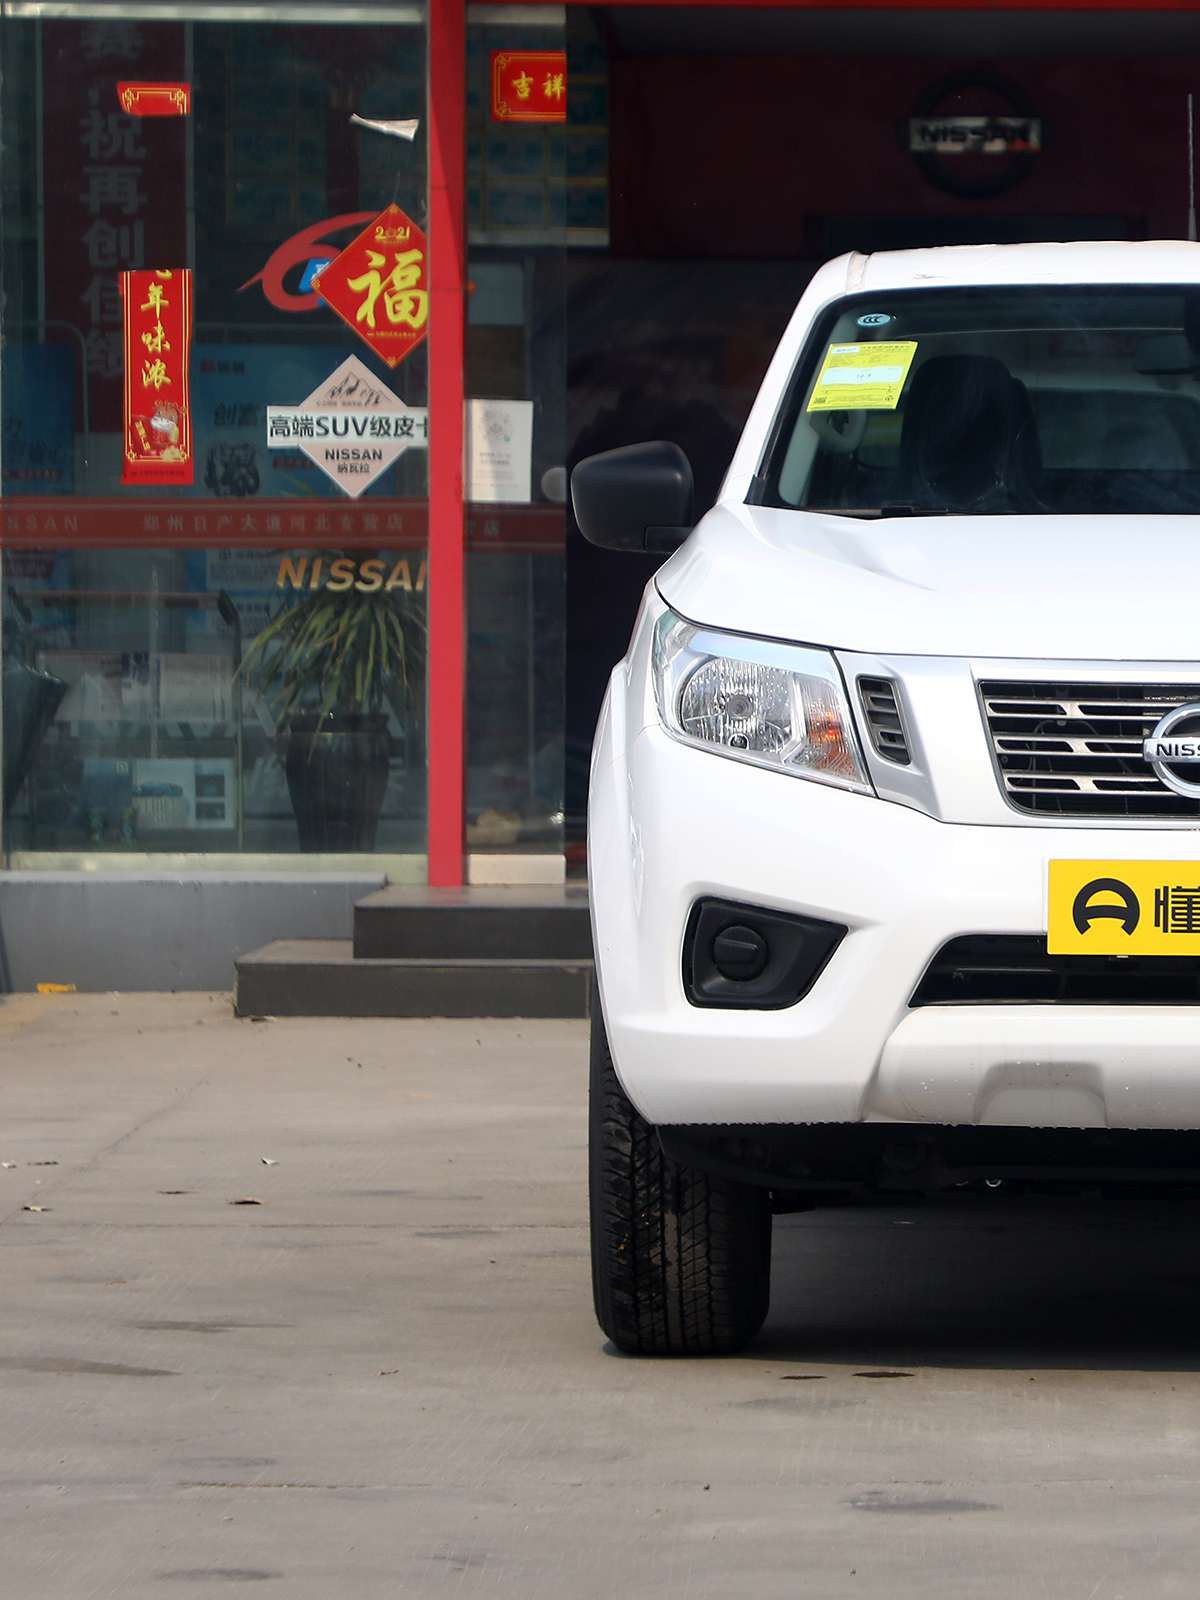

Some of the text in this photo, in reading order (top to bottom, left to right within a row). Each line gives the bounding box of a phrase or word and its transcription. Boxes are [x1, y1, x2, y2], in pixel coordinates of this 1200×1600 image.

[512, 71, 567, 102] 吉祥
[373, 226, 412, 240] 2021
[347, 248, 429, 328] 福
[141, 270, 172, 390] 年味浓
[325, 449, 383, 461] NISSAN
